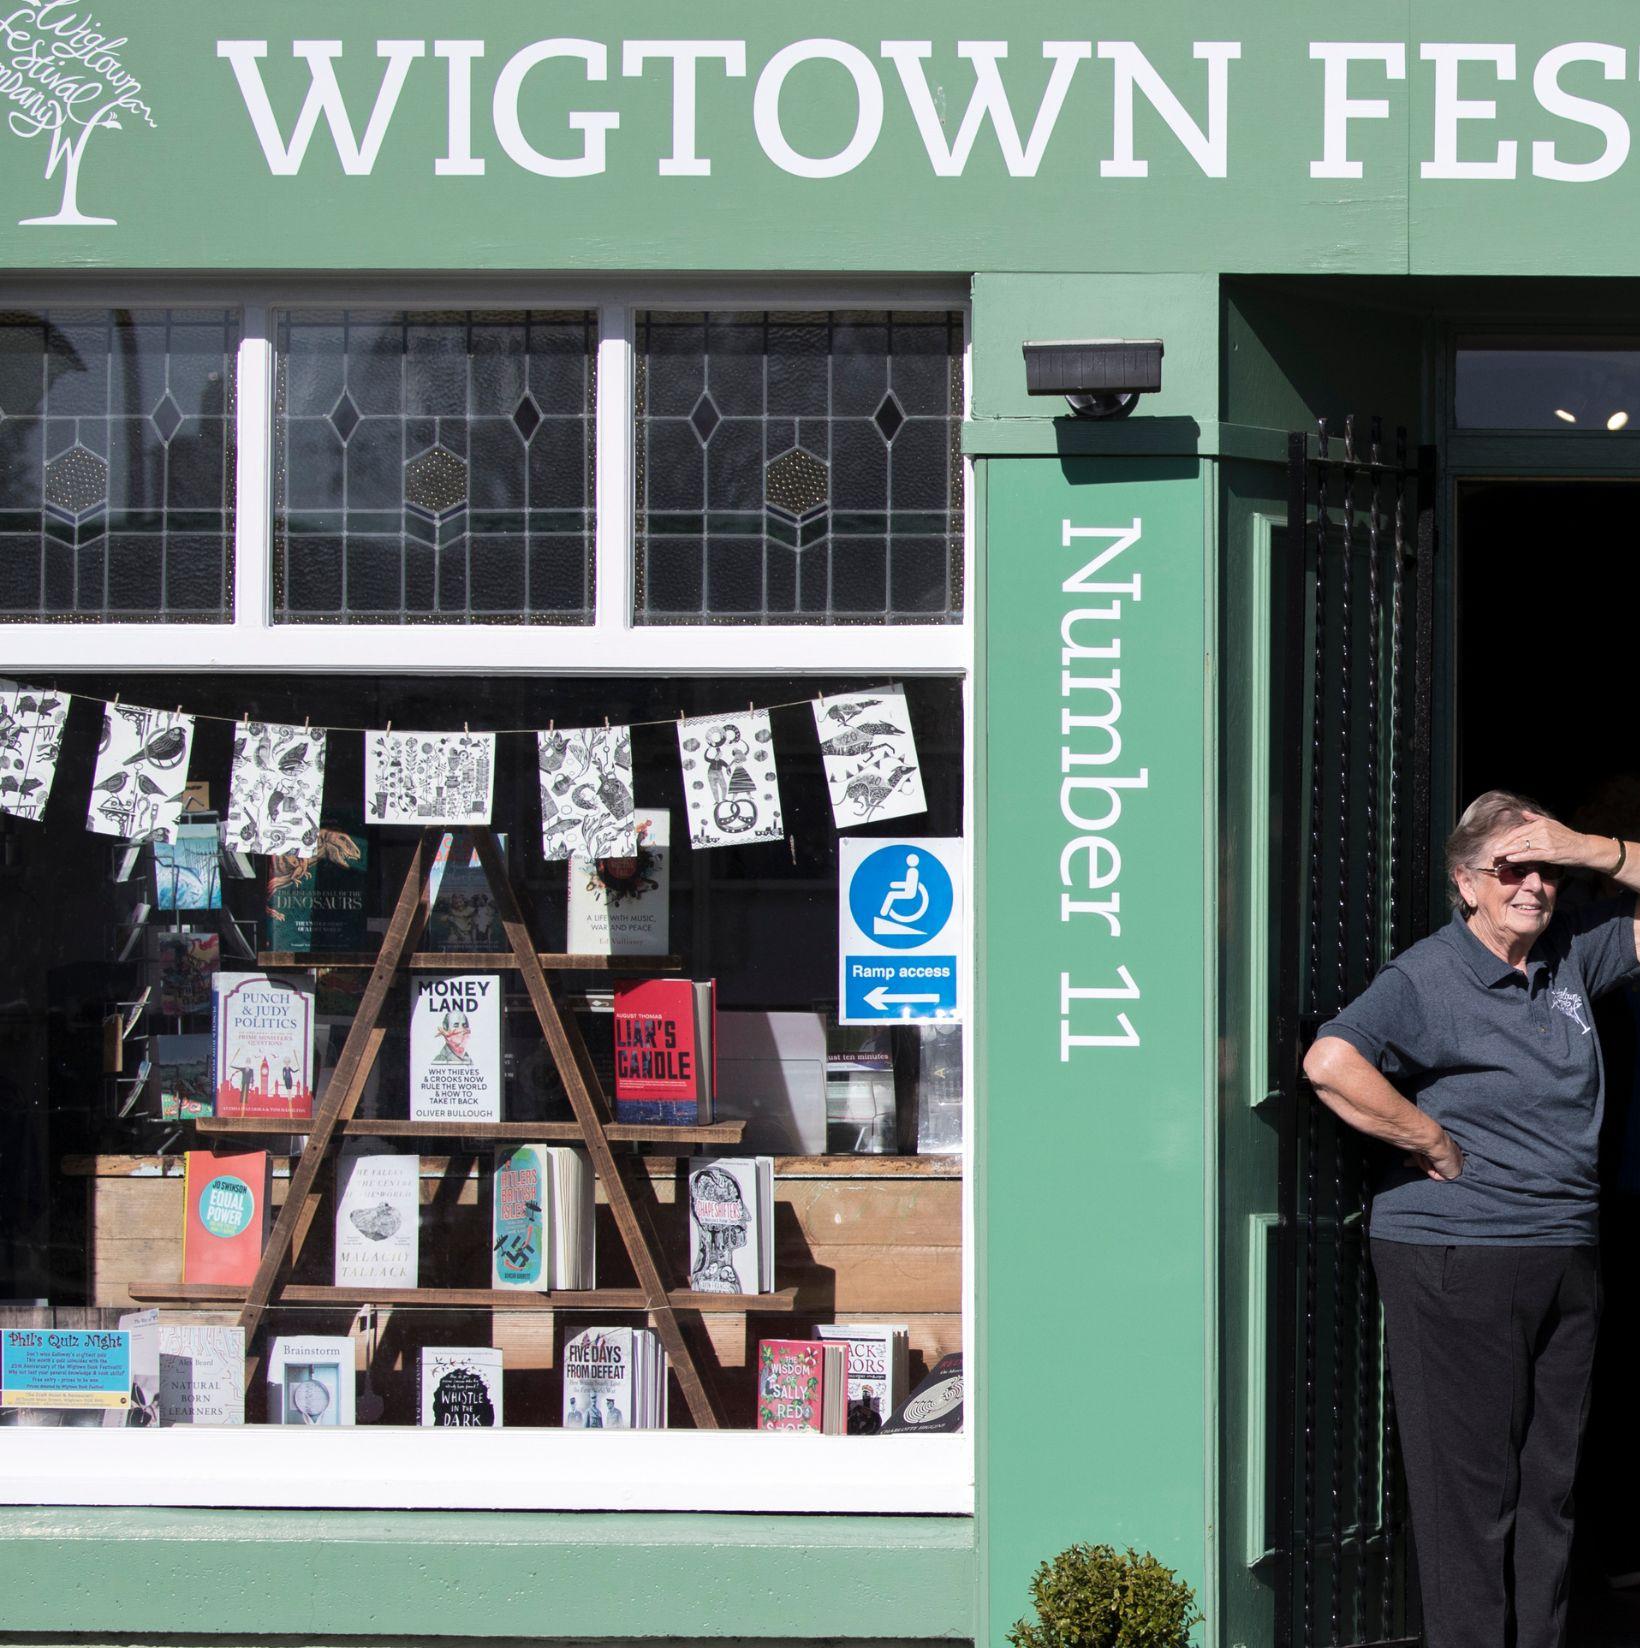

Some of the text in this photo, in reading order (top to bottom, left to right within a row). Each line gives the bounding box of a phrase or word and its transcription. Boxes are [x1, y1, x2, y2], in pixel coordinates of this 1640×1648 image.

[216, 38, 1242, 179] WIGTOWN
[1059, 517, 1149, 1063] Number 11
[277, 896, 362, 910] DINOSAURS
[852, 965, 950, 981] Ramp access
[418, 981, 490, 996] MONEY
[242, 993, 290, 1004] PUNCH
[242, 1005, 291, 1018] & JUDY
[429, 999, 479, 1013] LAND
[234, 1018, 297, 1029] POLITICS
[616, 1019, 676, 1049] LIAR'S
[428, 1068, 446, 1076] WHY
[618, 1050, 690, 1080] CANDLE
[458, 1083, 487, 1091] WORLD
[429, 1097, 448, 1105] TAKE
[450, 1097, 457, 1105] IT
[416, 1109, 493, 1117] OLIVER BULLOUGH
[212, 1180, 248, 1193] JO SWINSON
[209, 1188, 244, 1210] EQUAL
[206, 1206, 243, 1225] POWER
[8, 1331, 123, 1351] Phil's Quiz Night
[284, 1345, 340, 1355] Brainstorm
[569, 1345, 621, 1363] FIVE DAYS
[567, 1364, 625, 1379] FROM DEFEAT
[771, 1364, 811, 1375] WISDOM
[171, 1382, 221, 1390] NATURAL
[772, 1384, 809, 1400] SALLY
[441, 1390, 483, 1404] WHISTLE
[169, 1408, 223, 1416] LEARNERS
[777, 1404, 804, 1418] RED
[443, 1412, 482, 1427] DARK
